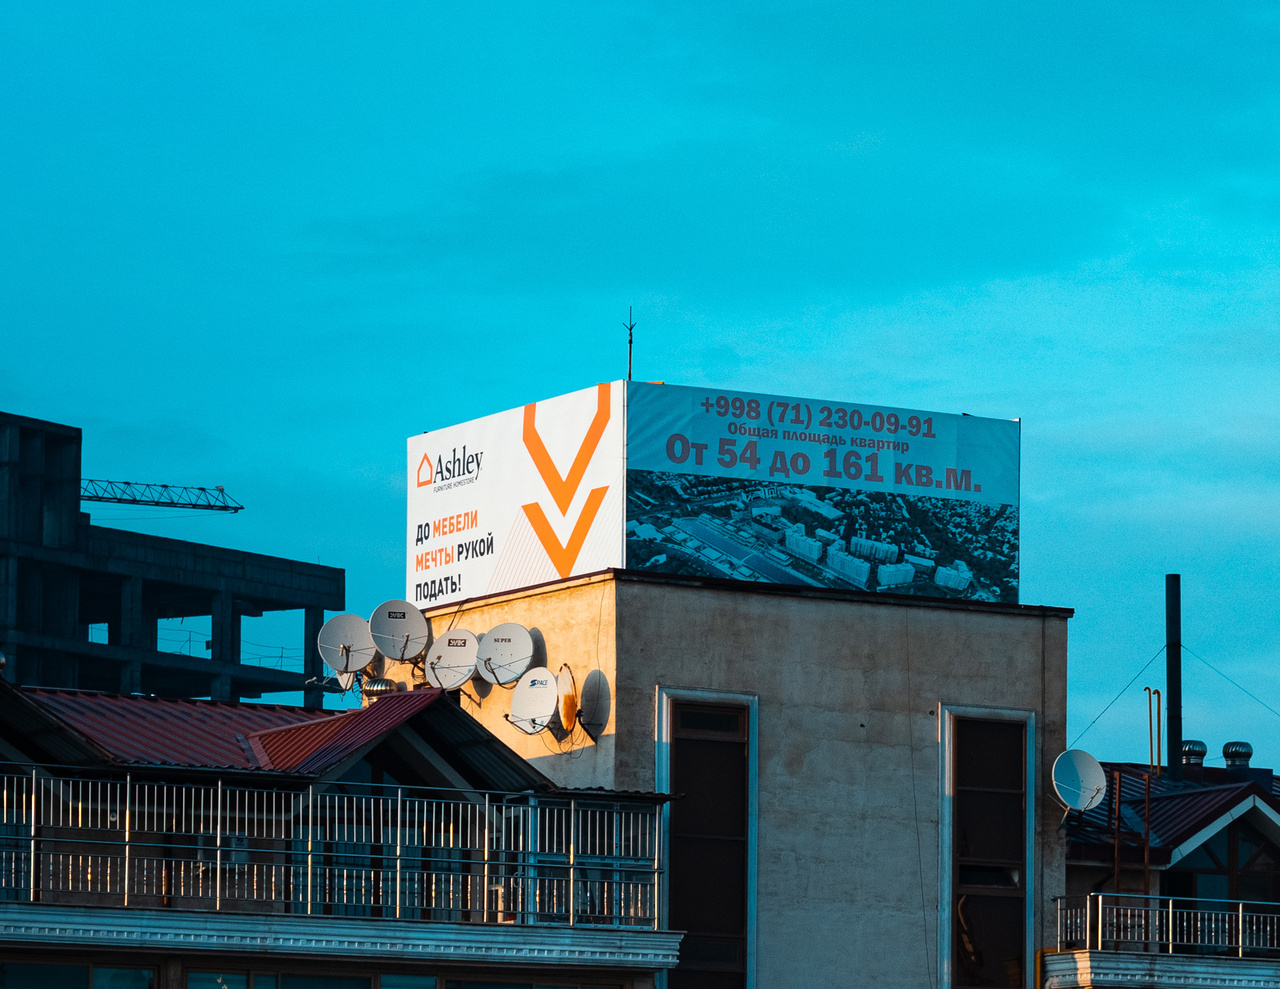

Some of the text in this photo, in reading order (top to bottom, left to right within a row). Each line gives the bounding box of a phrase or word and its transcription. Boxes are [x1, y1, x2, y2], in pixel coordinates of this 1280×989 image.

[701, 395, 936, 438] +998 (71) 230-09-91
[728, 422, 909, 454] Общая площадь квартир
[433, 445, 483, 483] Ashley
[666, 433, 708, 466] От
[717, 438, 760, 470] 54
[769, 450, 811, 478] до
[823, 448, 884, 483] 161
[415, 509, 478, 546] ДО МЕБЕЛИ
[415, 532, 494, 572] МЕЧТЫ РУКОЙ
[415, 574, 461, 602] ПОДАТЬ!
